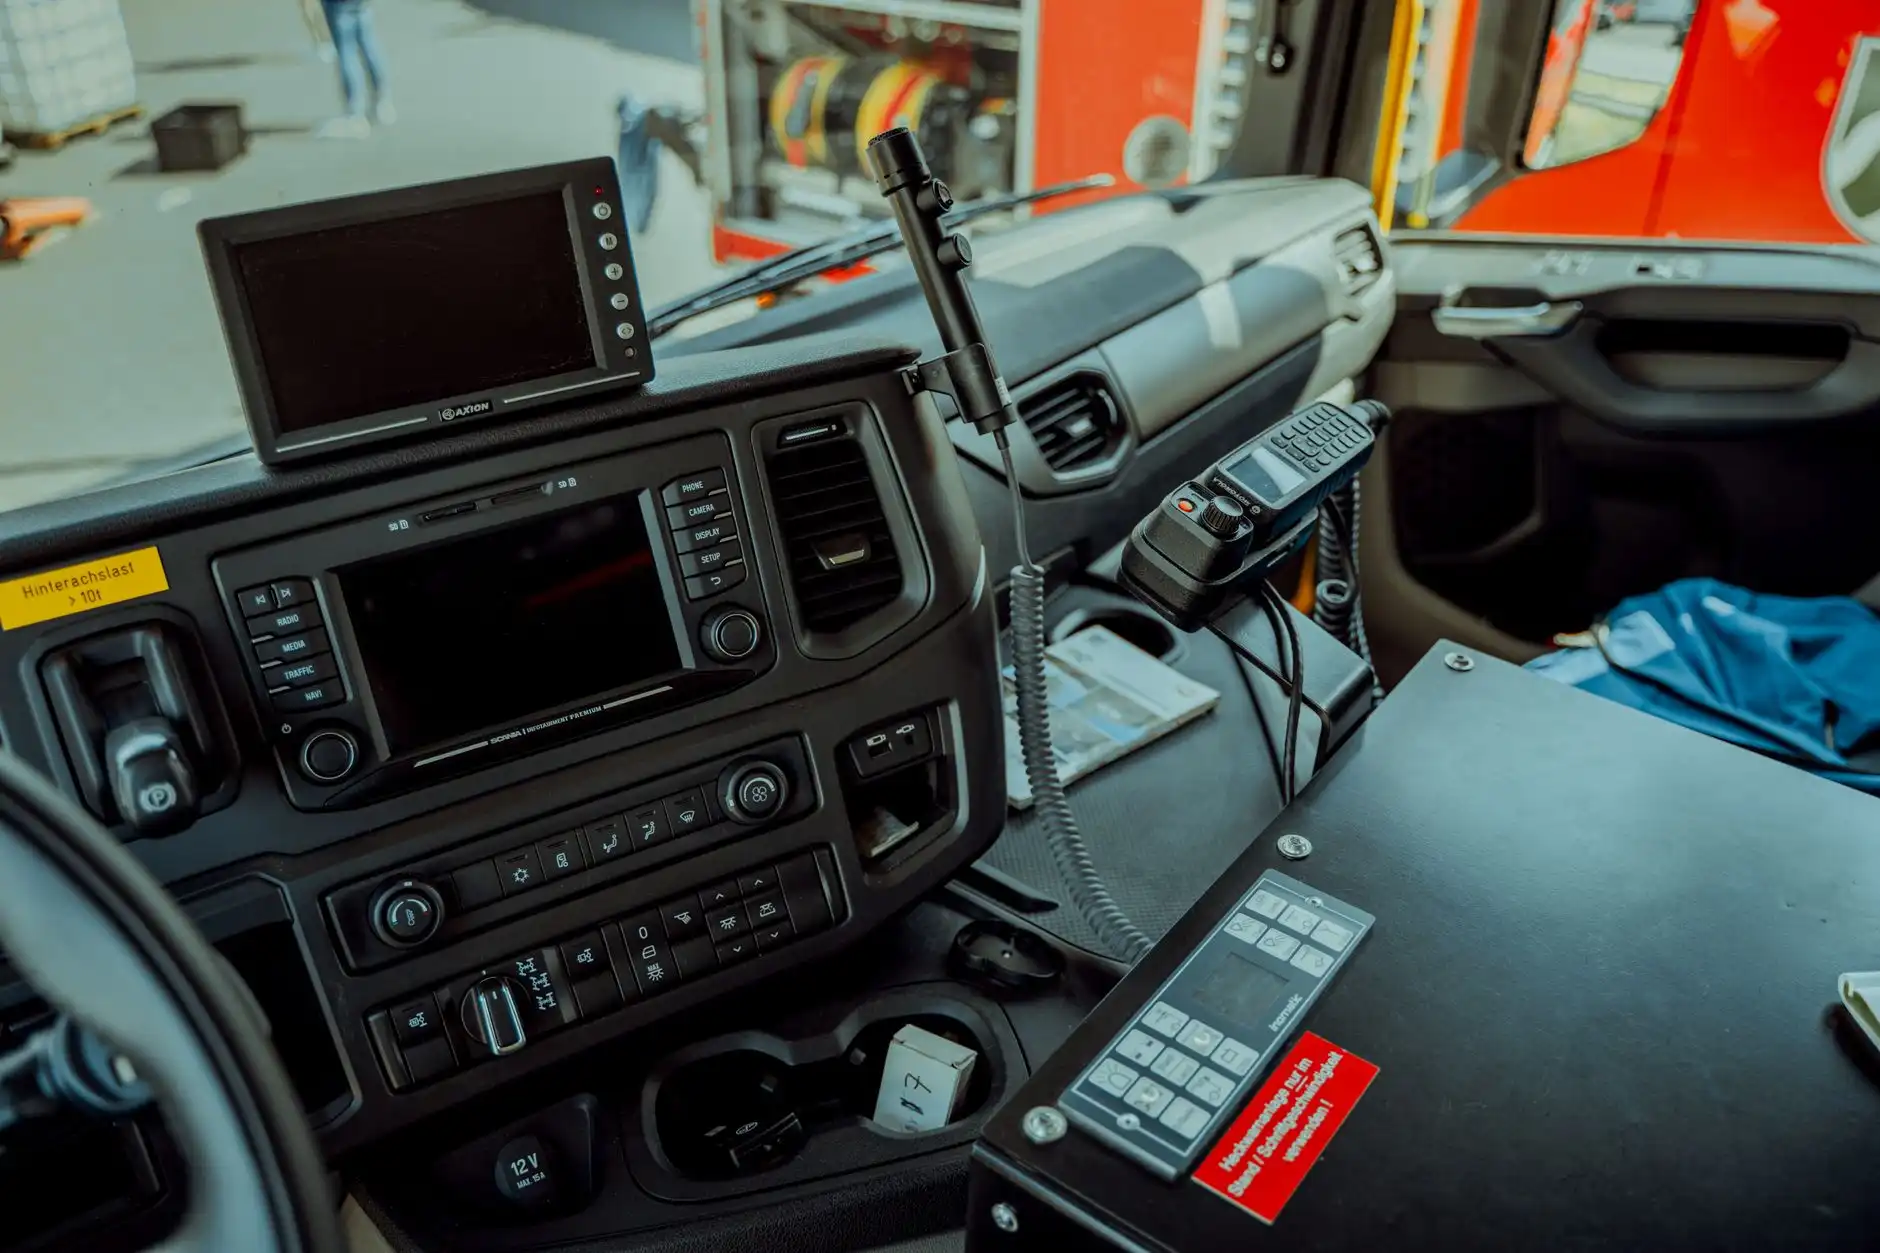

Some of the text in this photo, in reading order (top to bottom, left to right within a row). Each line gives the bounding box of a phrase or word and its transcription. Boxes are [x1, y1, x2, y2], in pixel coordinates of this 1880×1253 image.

[455, 402, 489, 417] AXION
[558, 480, 567, 489] SD
[682, 481, 704, 493] PHONE
[1213, 477, 1251, 507] MOTOROLA
[688, 503, 715, 517] CAMERA
[695, 527, 720, 541] DISPLAY
[701, 552, 721, 564] SETUP
[22, 561, 135, 599] Hinterachslast
[80, 588, 102, 605] 10t
[276, 614, 299, 626] RADIO
[282, 639, 306, 653] MEDIA
[284, 665, 315, 680] TRAFFIC
[304, 690, 323, 702] NAVI
[490, 705, 602, 744] SCANIA INFOTAINMENT PREMIUM
[647, 963, 659, 972] MAX
[1268, 993, 1303, 1032] inomatic
[1284, 1071, 1304, 1090] nur
[1295, 1057, 1313, 1073] im
[1227, 1161, 1261, 1197] Stand
[1256, 1051, 1344, 1158] Schrittgeschwindigkeit
[1283, 1106, 1329, 1162] verwenden
[511, 1152, 538, 1176] 12 V
